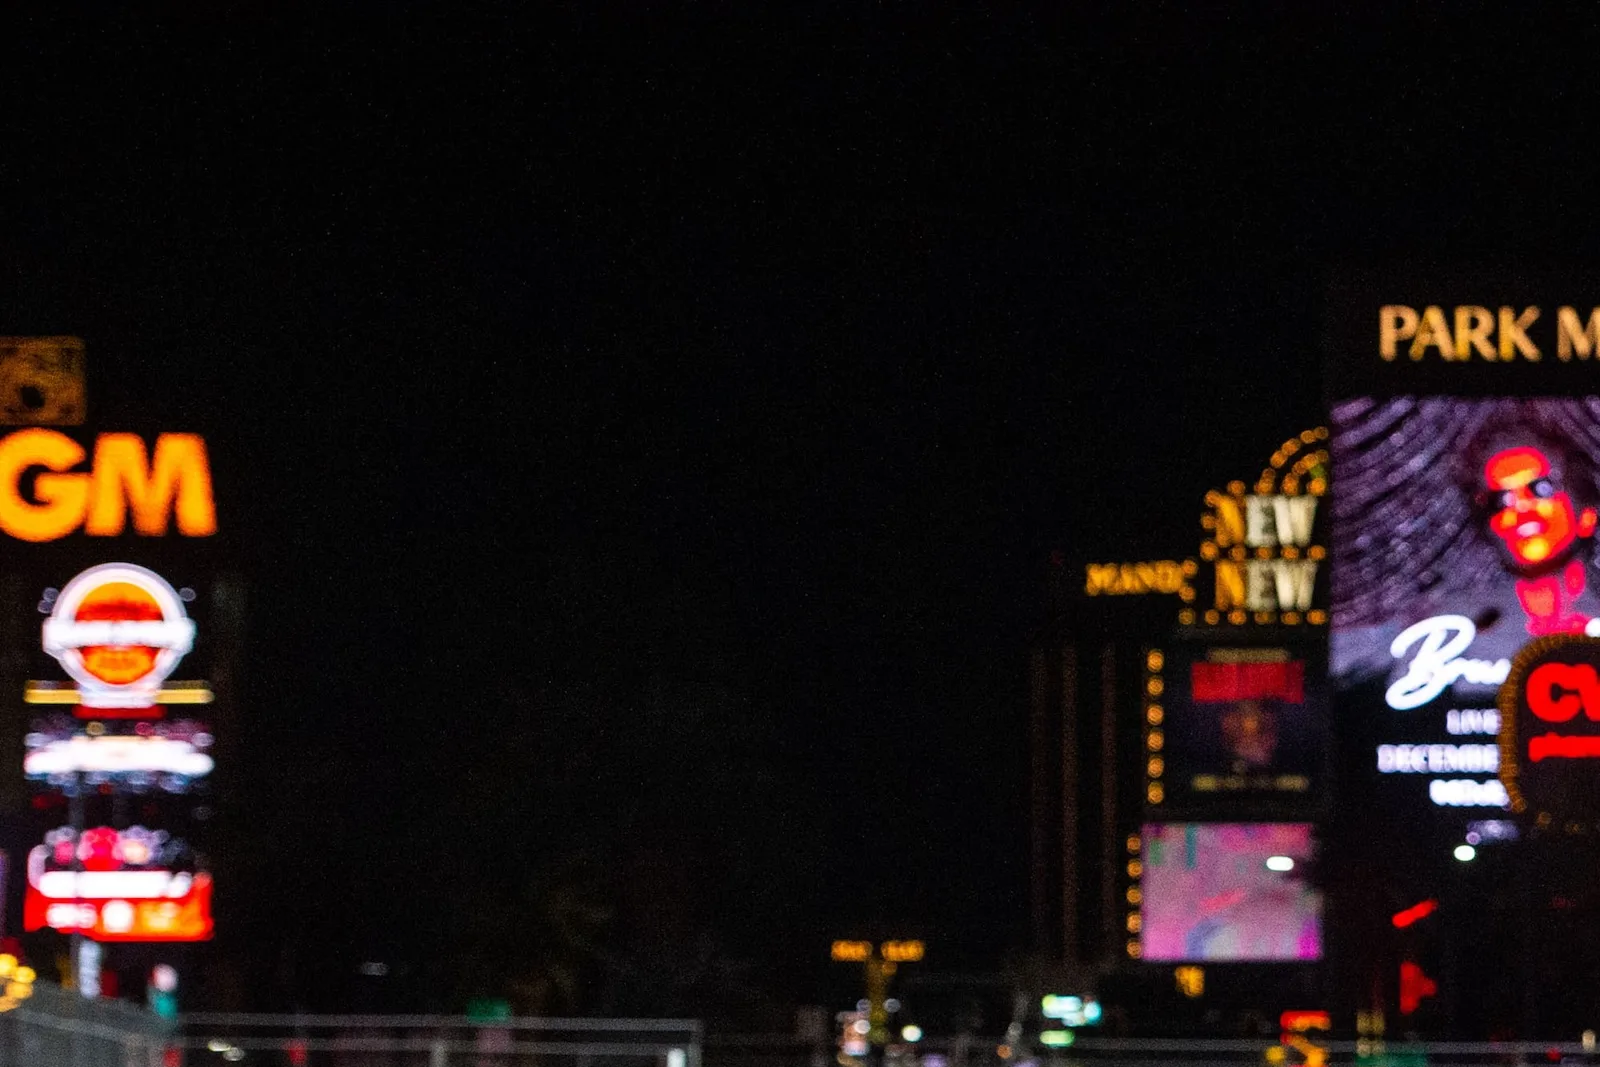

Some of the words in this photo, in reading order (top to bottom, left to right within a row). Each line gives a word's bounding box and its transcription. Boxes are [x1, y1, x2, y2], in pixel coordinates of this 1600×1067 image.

[1379, 306, 1541, 361] PARK
[1215, 494, 1318, 548] NEW
[1215, 557, 1318, 611] NEW
